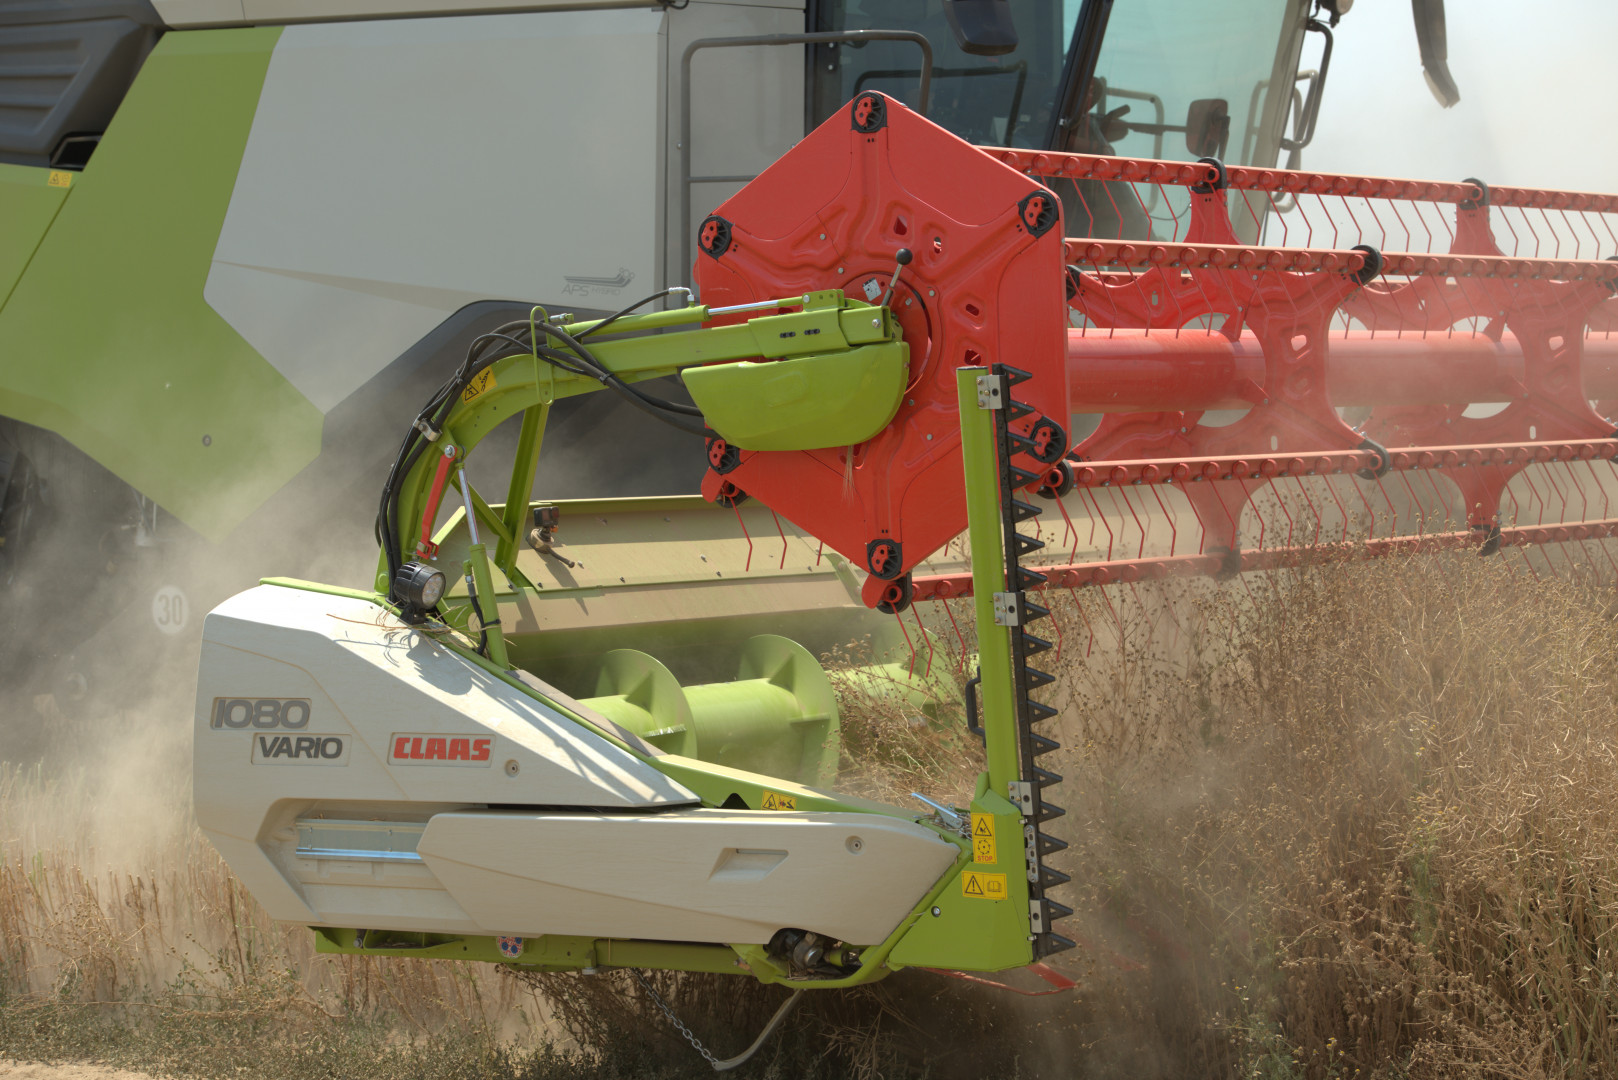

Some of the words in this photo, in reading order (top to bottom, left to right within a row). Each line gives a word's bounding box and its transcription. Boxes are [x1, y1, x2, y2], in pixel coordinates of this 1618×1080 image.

[561, 284, 589, 296] APS
[159, 595, 182, 625] 30
[214, 699, 310, 728] 1080
[259, 736, 343, 759] VARIO
[393, 737, 491, 761] CLAAS
